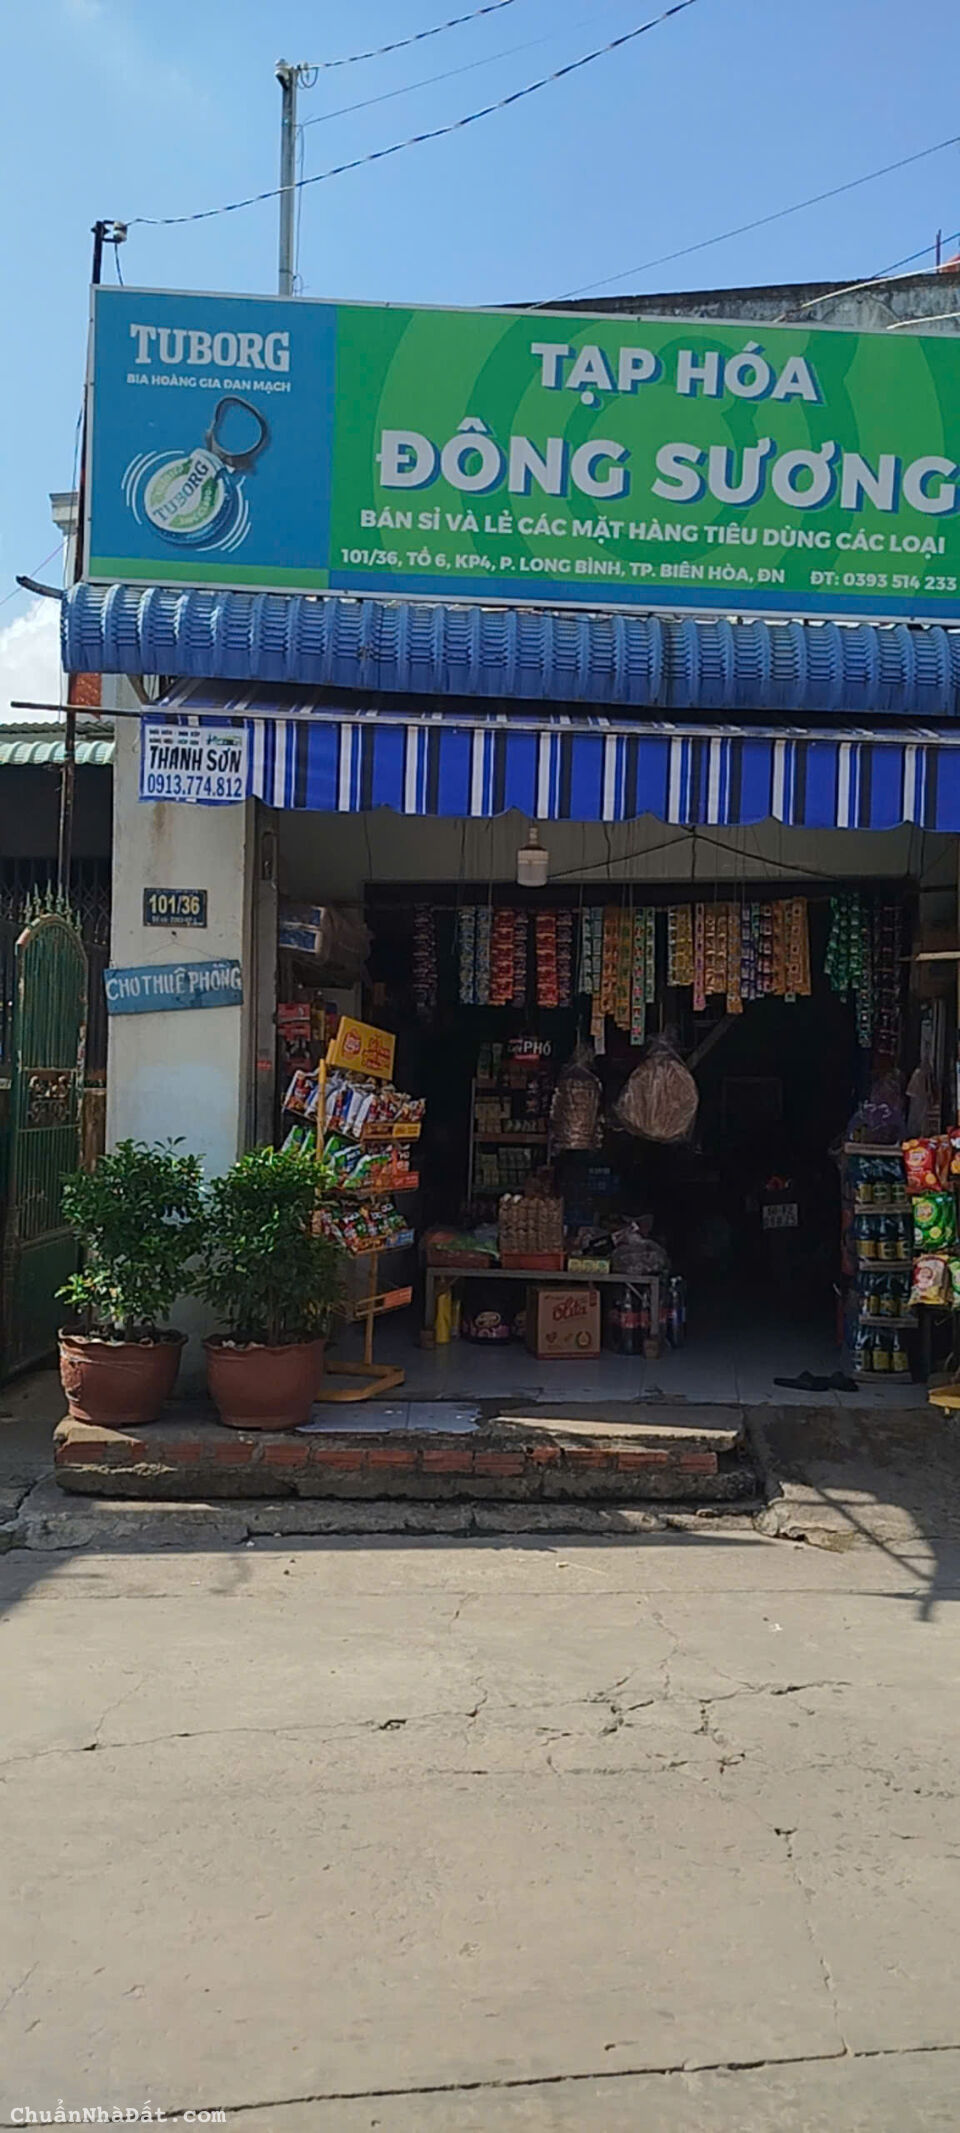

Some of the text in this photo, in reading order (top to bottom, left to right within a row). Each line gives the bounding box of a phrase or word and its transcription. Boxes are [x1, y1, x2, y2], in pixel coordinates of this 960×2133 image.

[130, 324, 290, 372] TUBORG
[126, 373, 149, 386] BIA
[151, 374, 197, 389] HOÀNG
[199, 377, 221, 389] GIA
[254, 379, 291, 394] MẠCH
[530, 341, 819, 405] TẠP HÓA
[376, 417, 957, 515] ĐÔNG SƯƠNG
[153, 460, 209, 522] TUBORG
[360, 505, 945, 559] BÁN SỈ VÀ LẺ CÁC MẶT HÀNG TIÊU DÙNG CÁC LOẠI
[340, 545, 957, 591] 101/36, TỔ 6, KP4, P. LONG BÌNH, TP. BIÊN HÒA, ĐN ĐT: 0393 514 233
[150, 746, 242, 773] THANH SƠN
[147, 773, 242, 798] 0913.774.812
[149, 893, 201, 916] 101/36
[106, 975, 141, 1000] CHO
[141, 966, 186, 995] THUÊ
